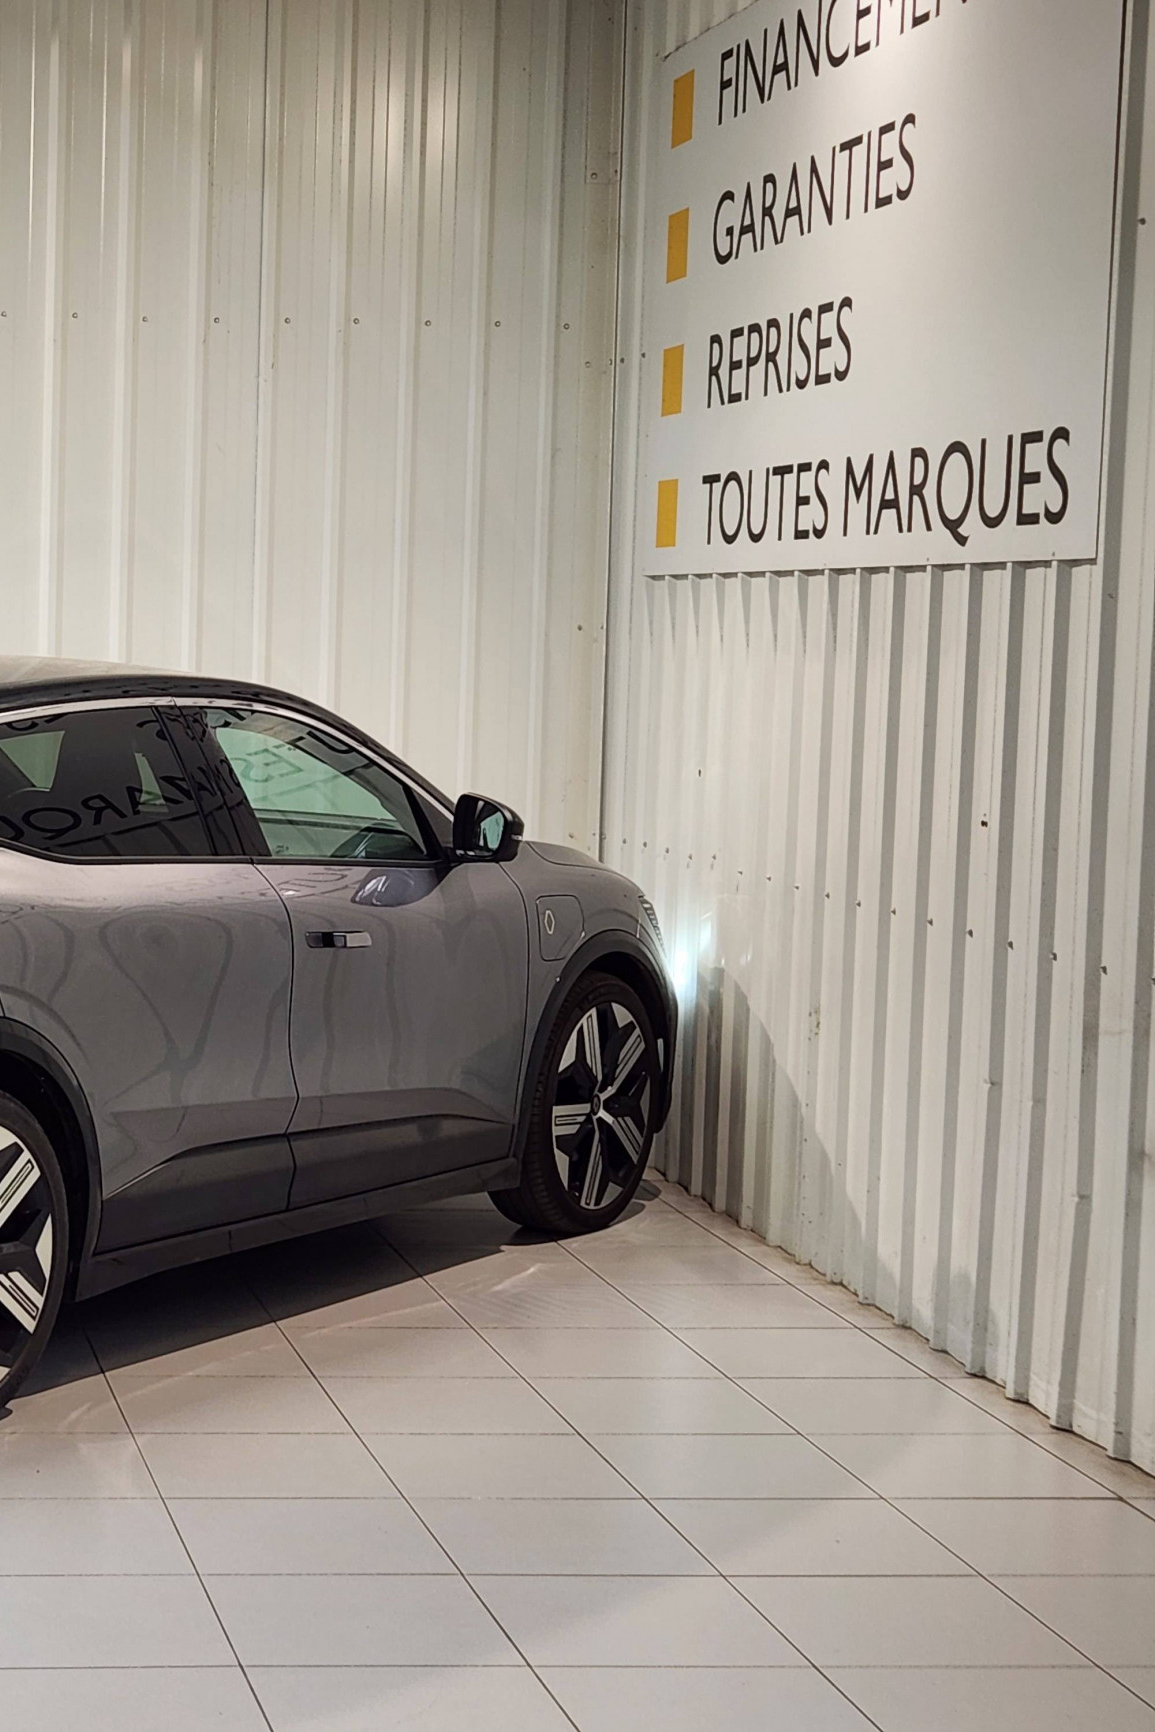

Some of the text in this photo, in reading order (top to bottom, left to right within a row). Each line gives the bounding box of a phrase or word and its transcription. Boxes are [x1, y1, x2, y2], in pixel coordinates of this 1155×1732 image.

[717, 0, 967, 126] FINANCEM
[712, 113, 916, 265] GARANTIES
[706, 296, 853, 409] REPRISES
[702, 426, 1071, 547] TOUTES MARQUES
